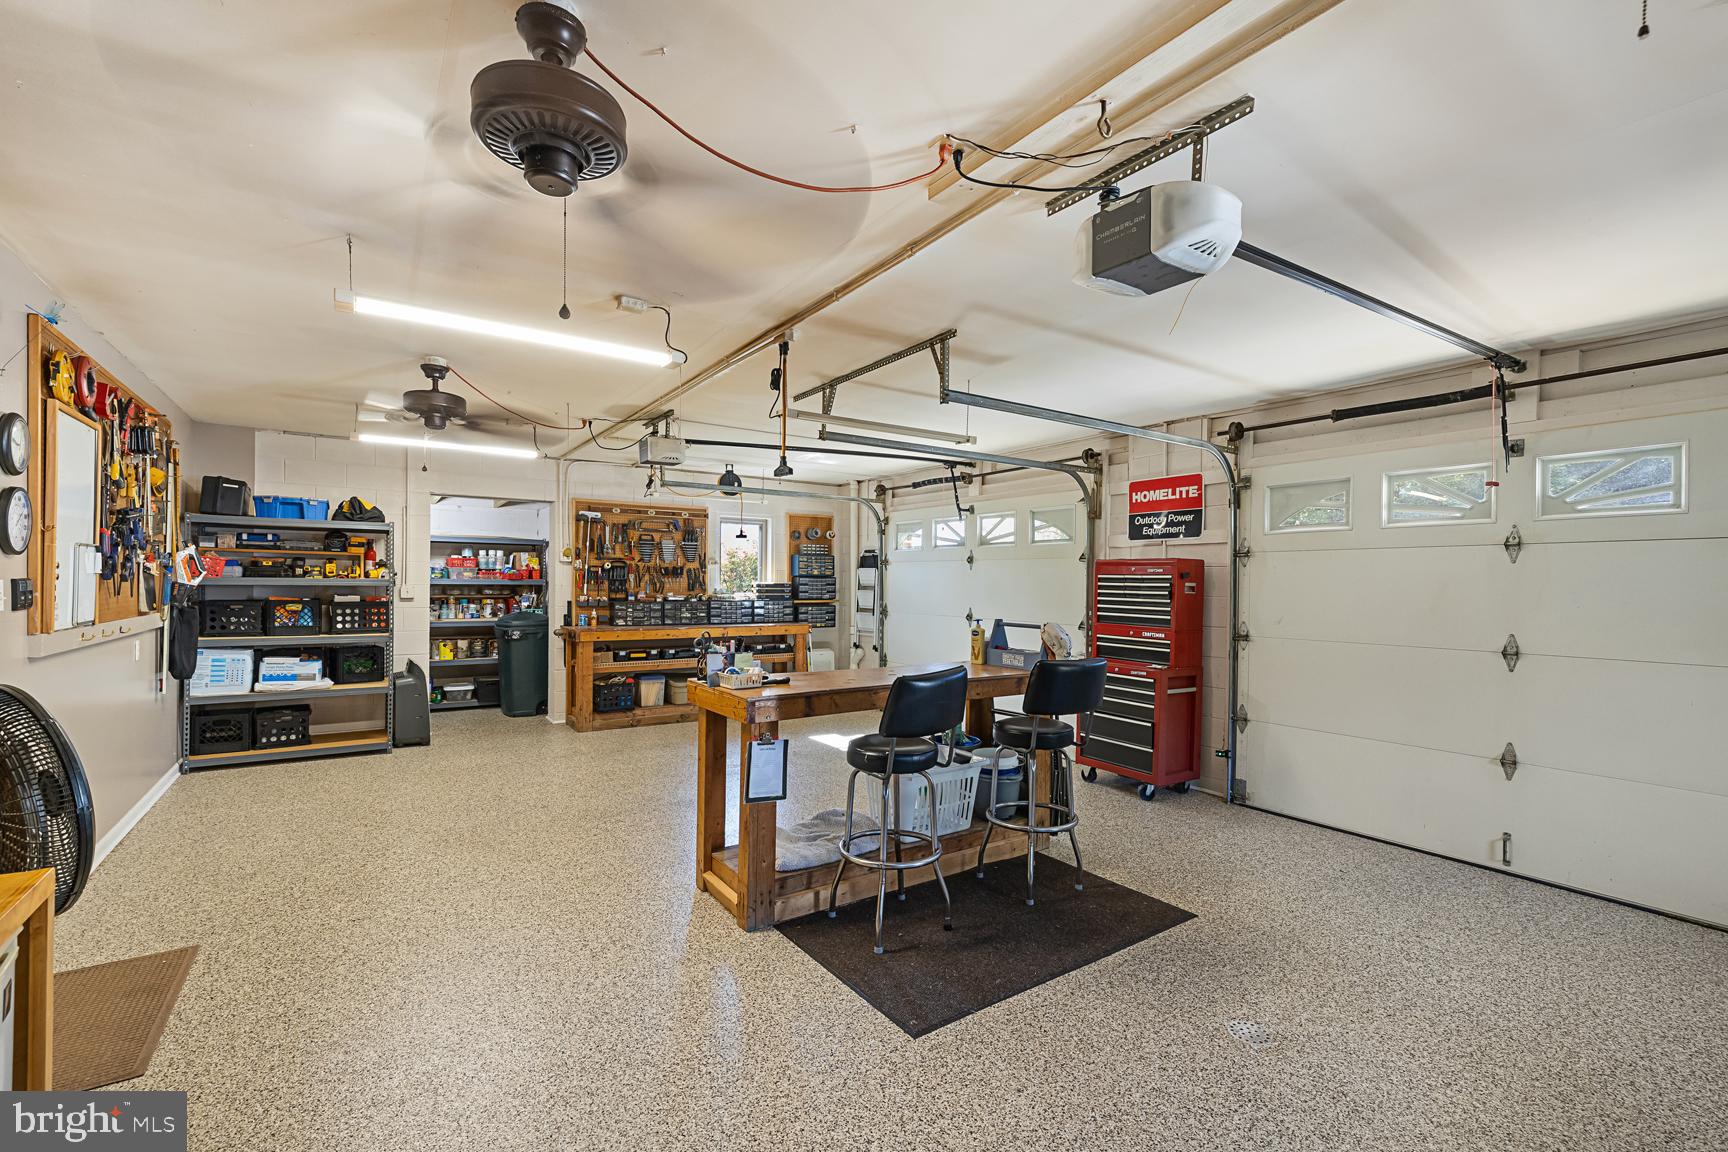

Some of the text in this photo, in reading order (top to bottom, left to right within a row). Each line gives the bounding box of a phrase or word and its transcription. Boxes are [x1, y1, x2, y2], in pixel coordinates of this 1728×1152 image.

[1096, 214, 1146, 240] CHAMBERLAIN
[1132, 486, 1198, 503] HOMELITE
[1168, 513, 1195, 523] Power
[1142, 525, 1185, 535] Equipment
